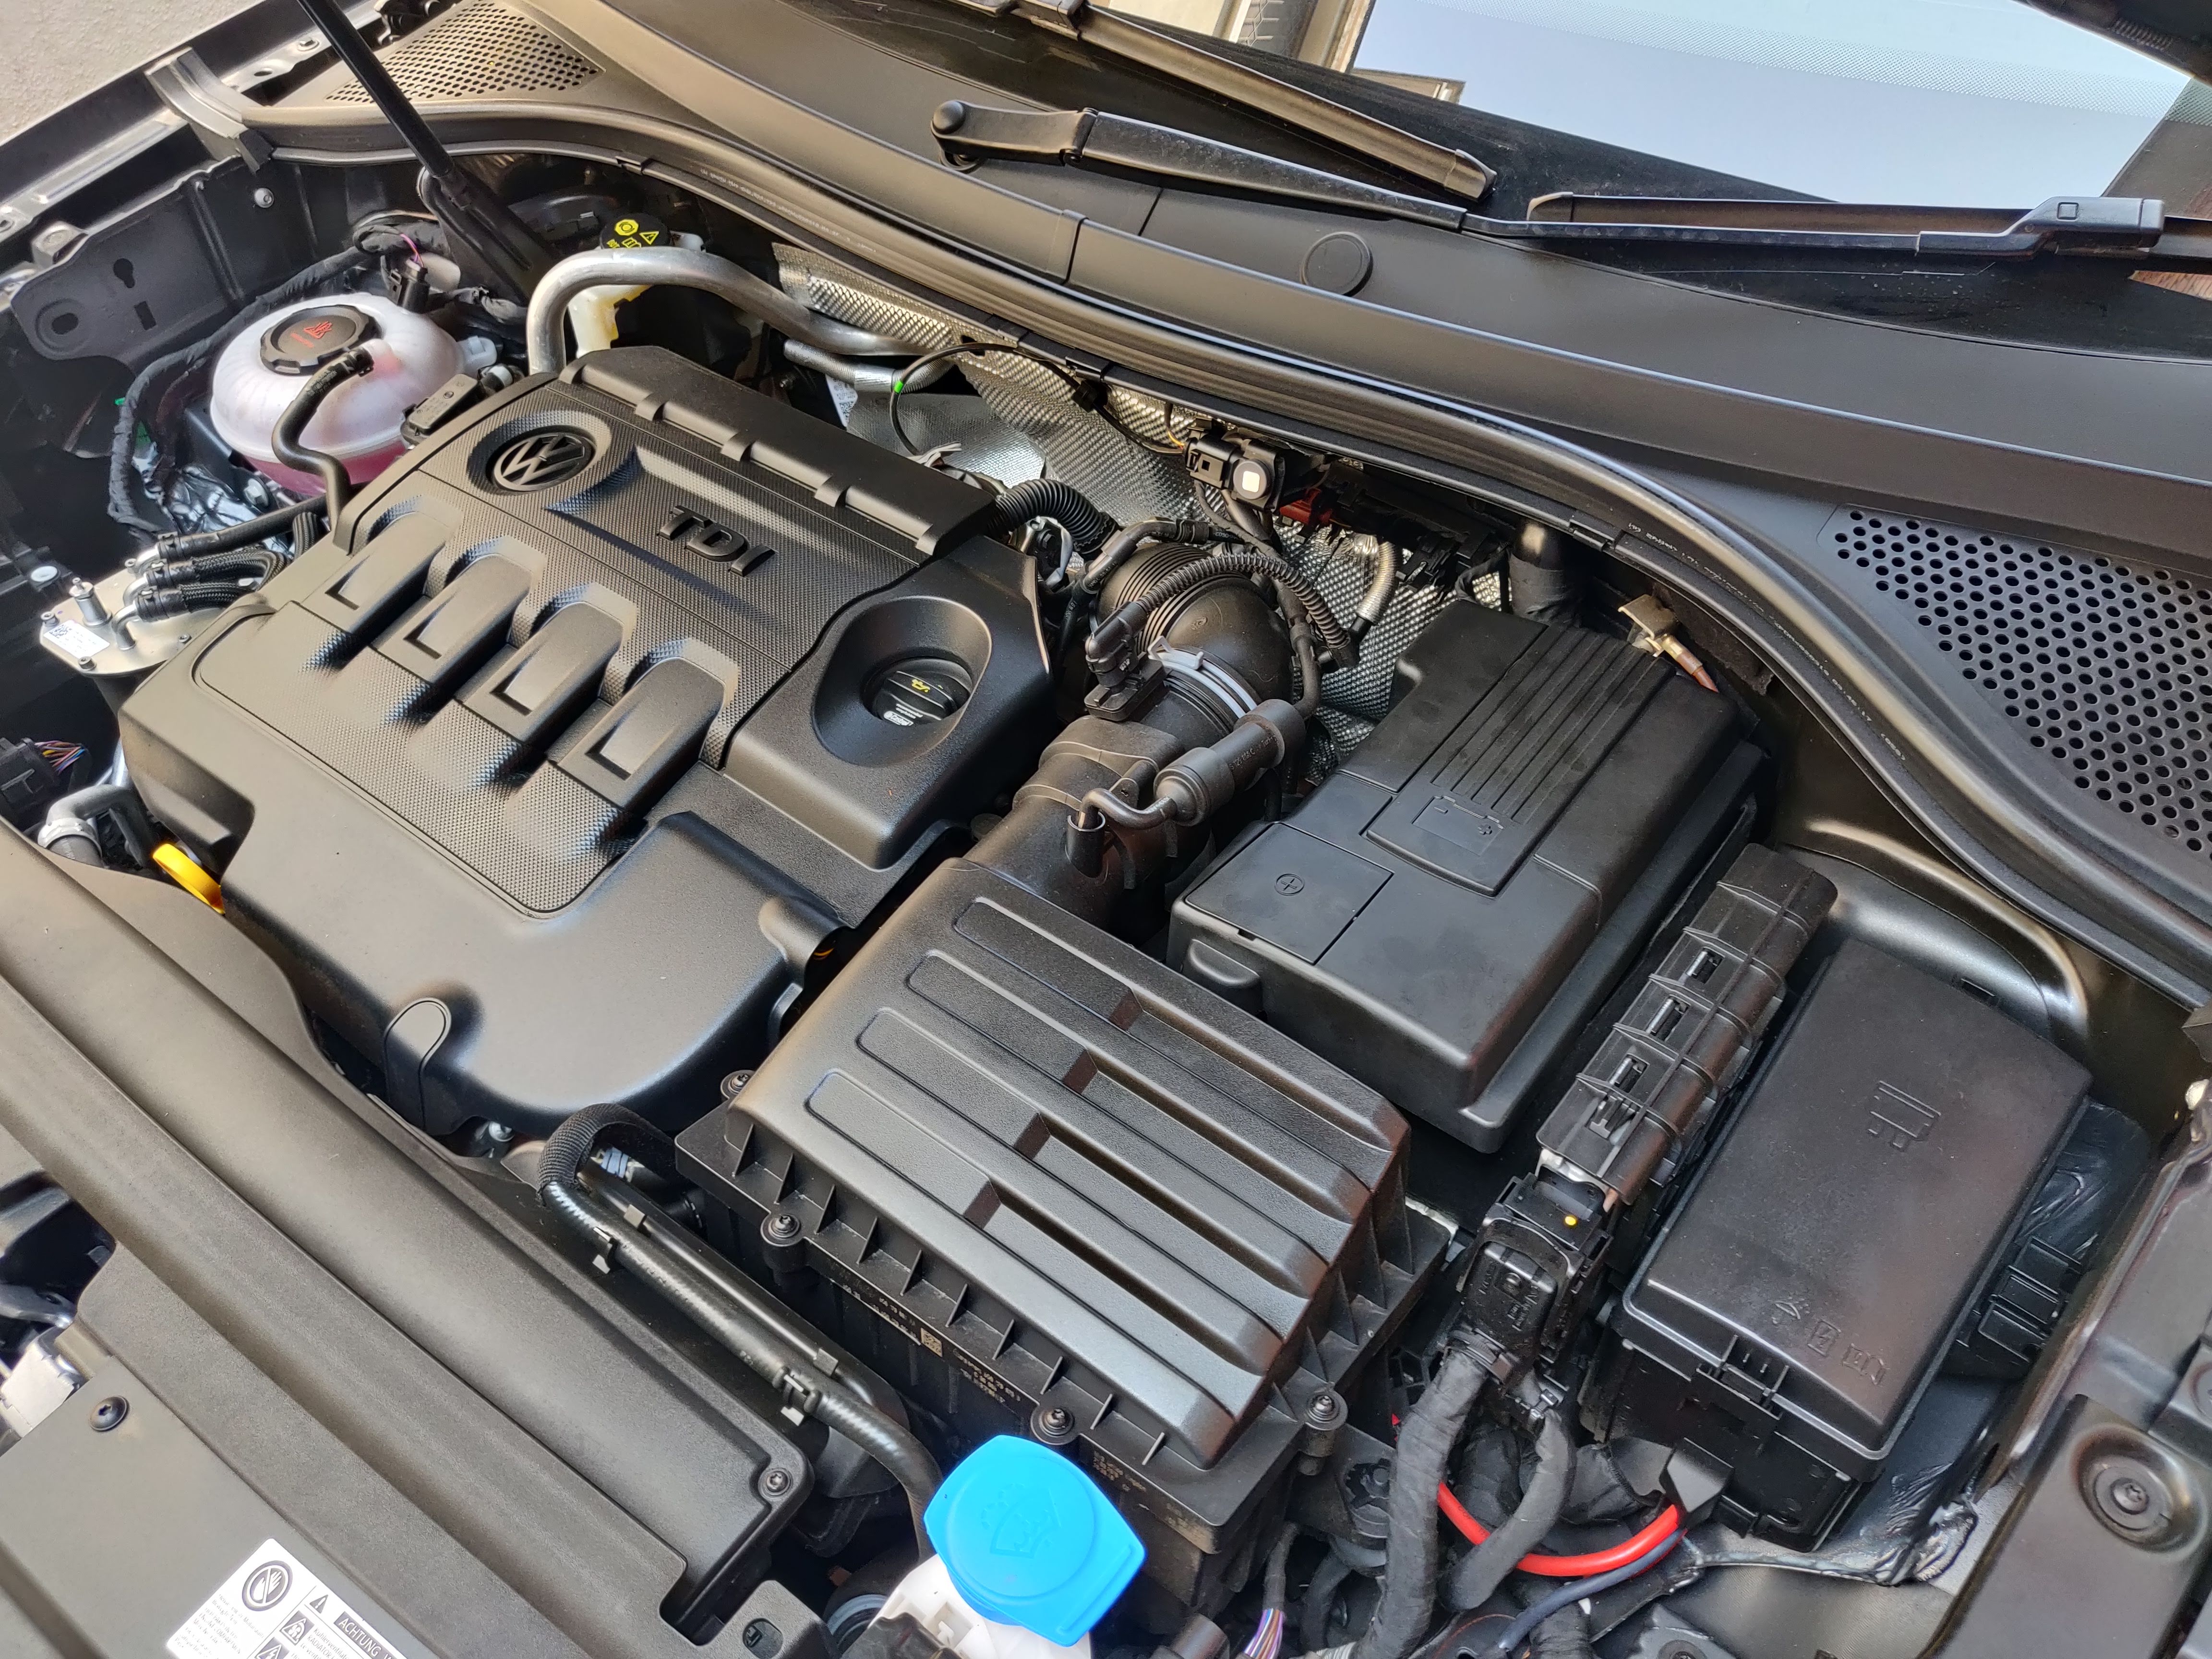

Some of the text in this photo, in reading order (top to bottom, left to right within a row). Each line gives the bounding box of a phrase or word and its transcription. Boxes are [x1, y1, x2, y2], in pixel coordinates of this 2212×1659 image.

[494, 432, 595, 492] VW
[659, 505, 779, 577] TDI
[338, 1618, 382, 1657] ACHTUNG
